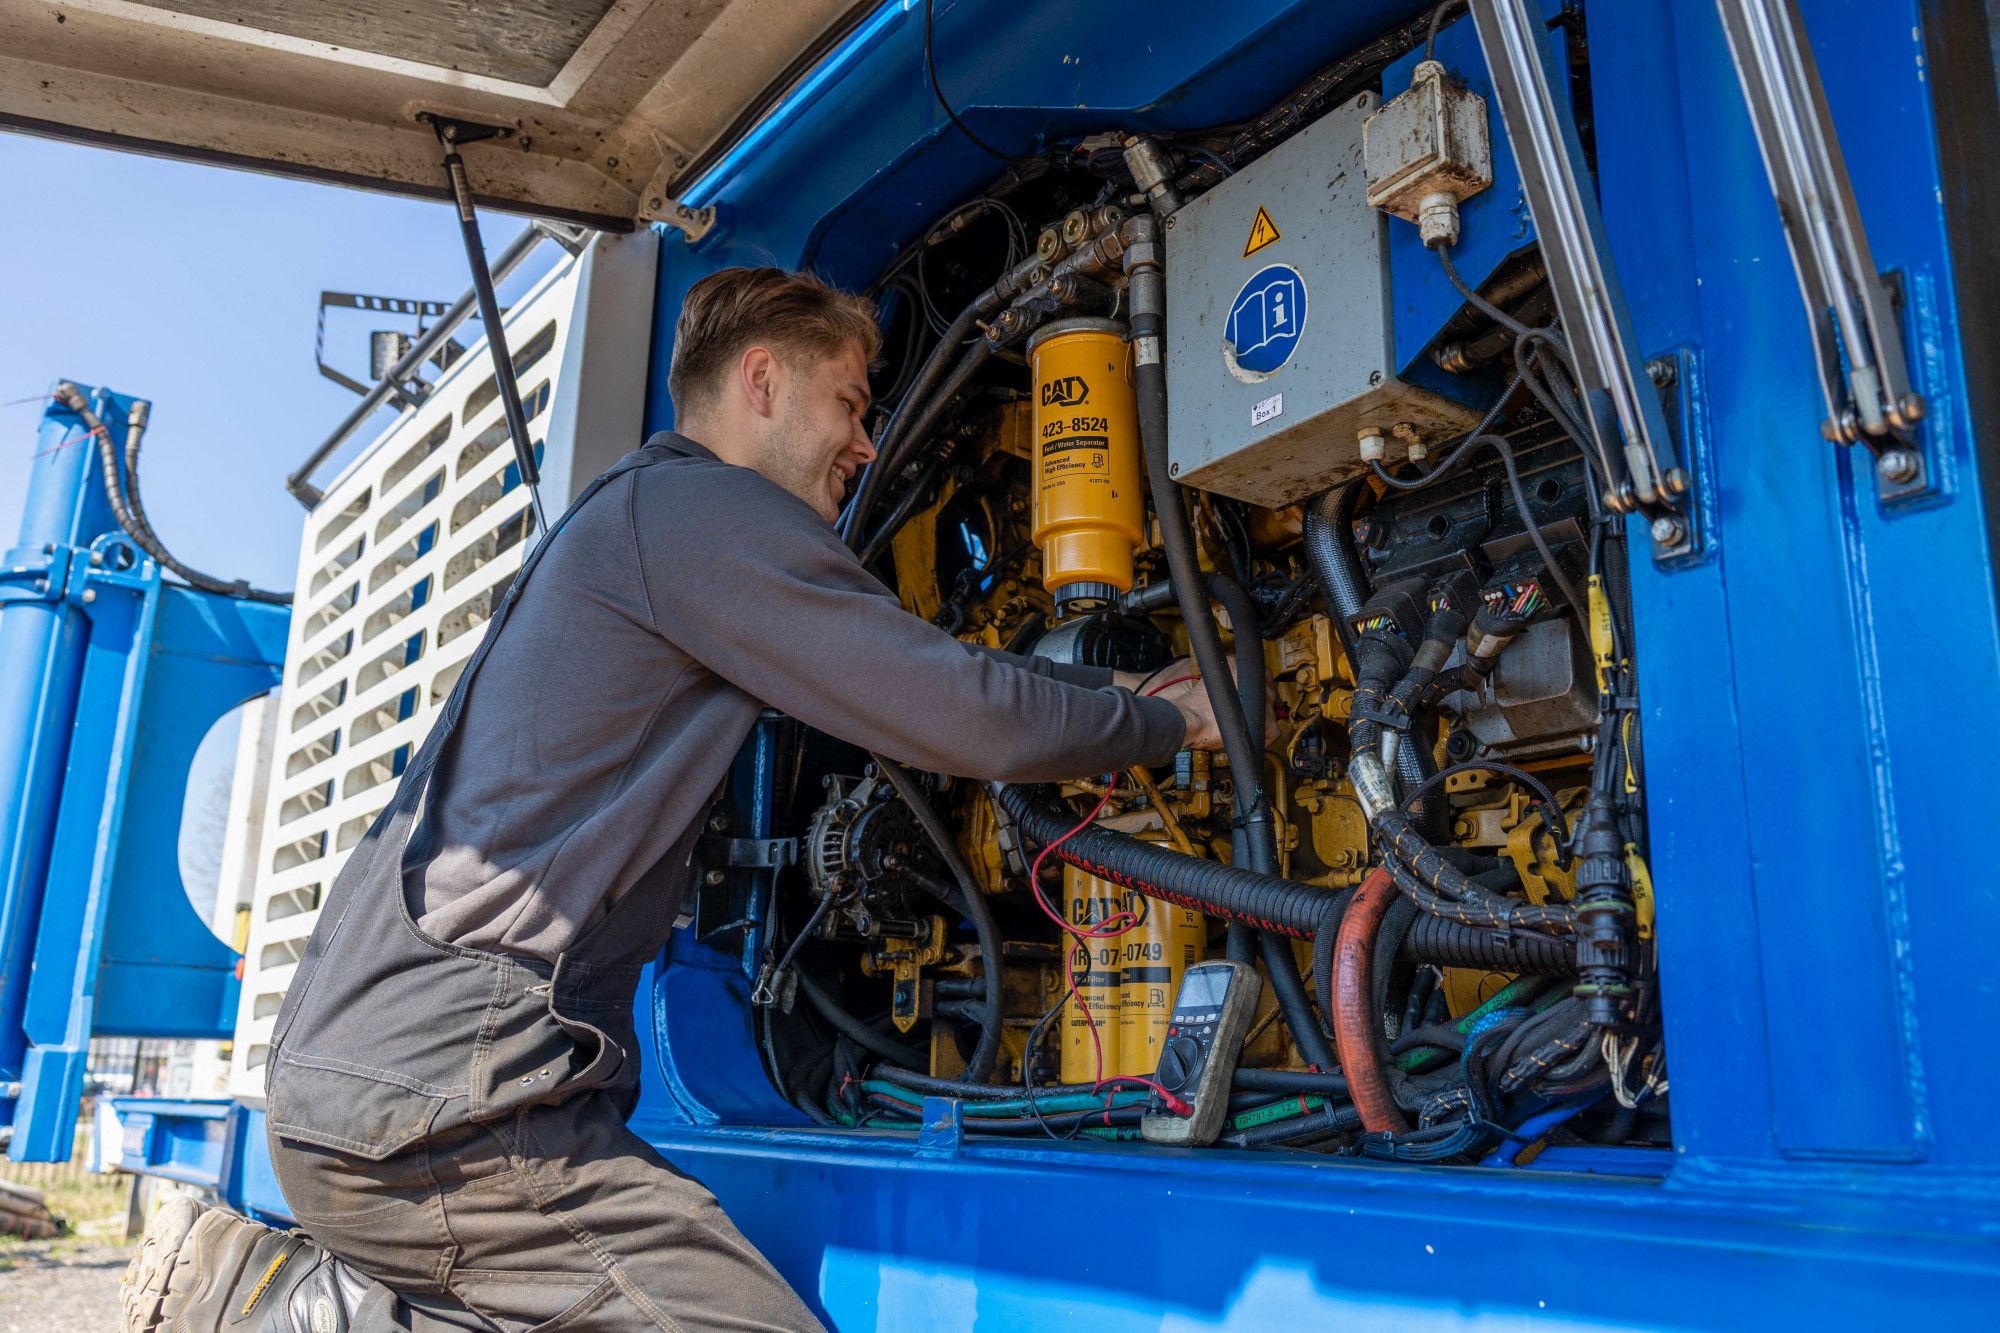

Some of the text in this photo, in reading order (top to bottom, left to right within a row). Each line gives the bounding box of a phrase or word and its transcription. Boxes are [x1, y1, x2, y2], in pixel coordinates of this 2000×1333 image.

[1042, 376, 1079, 407] CAT
[1256, 410, 1270, 420] Box
[1042, 417, 1108, 438] 423-8524
[1057, 440, 1075, 450] Water
[1075, 439, 1105, 448] Separator
[1045, 456, 1070, 468] Advanced
[1045, 462, 1086, 475] High Efficiency
[1073, 897, 1114, 926] CAT
[1088, 975, 1105, 983] Filter
[1281, 1101, 1298, 1113] 12.7
